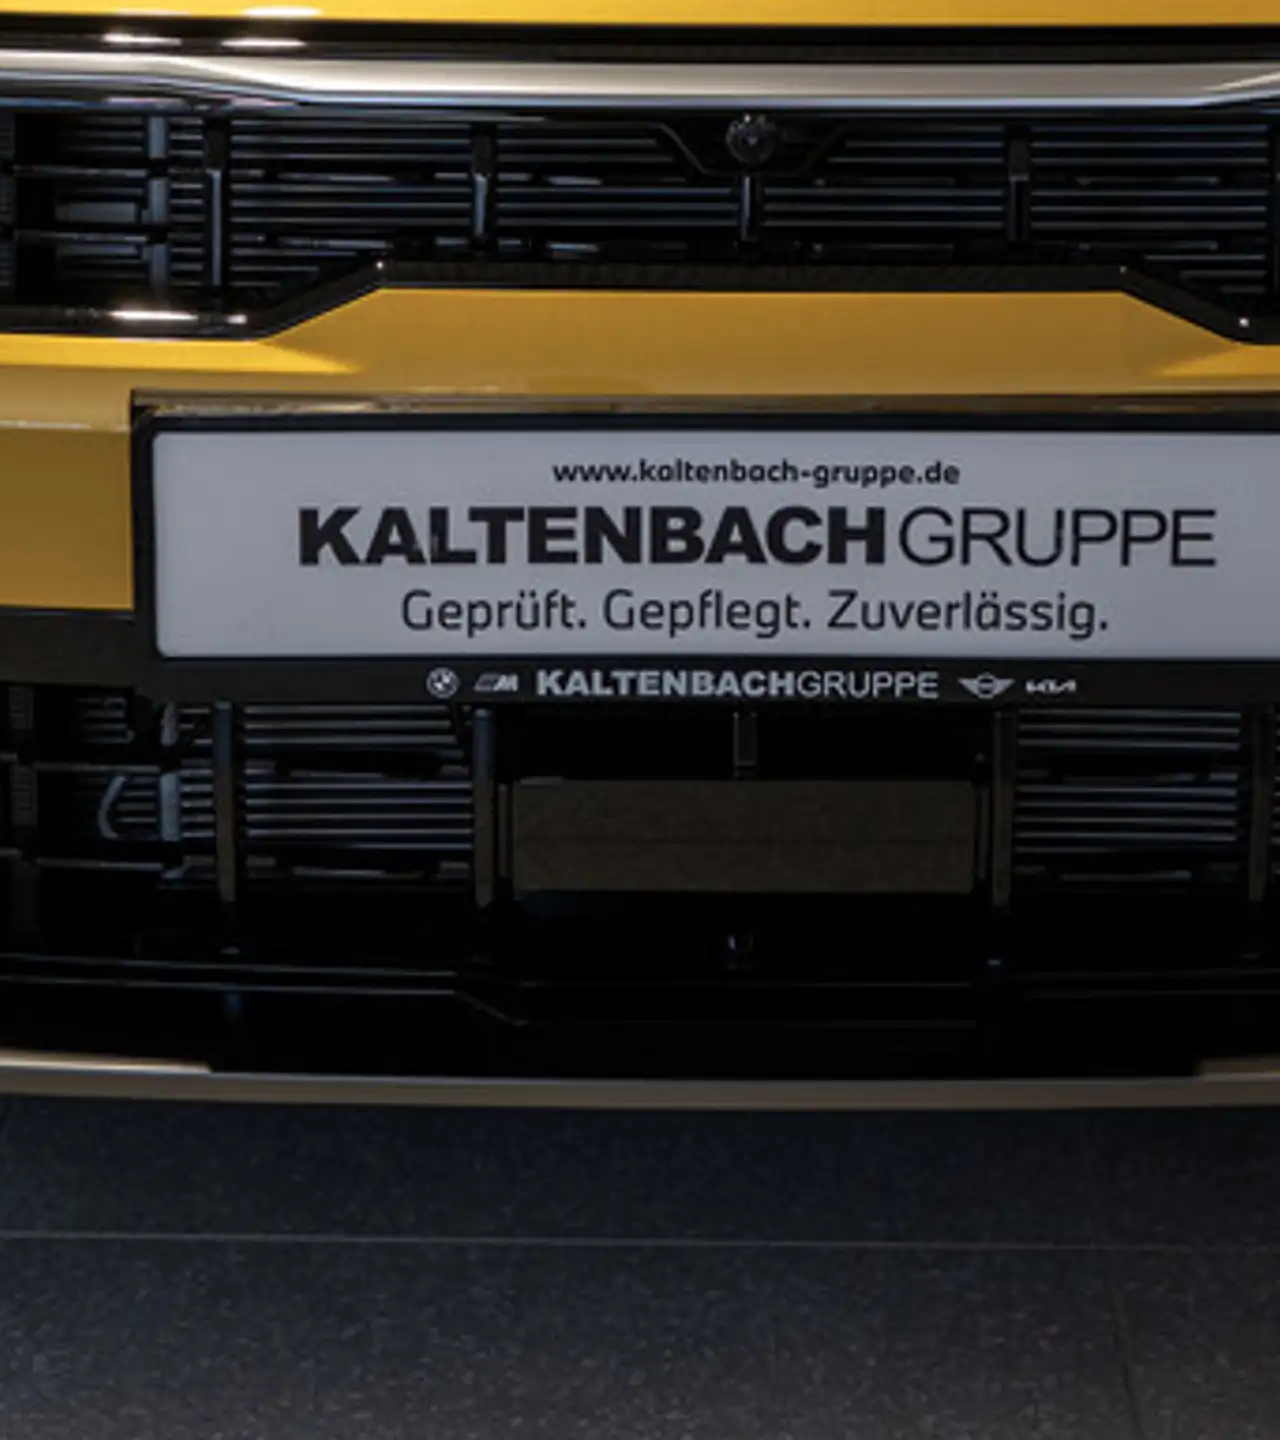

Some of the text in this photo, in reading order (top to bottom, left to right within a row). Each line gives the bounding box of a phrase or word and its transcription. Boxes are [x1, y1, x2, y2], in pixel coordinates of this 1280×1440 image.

[552, 457, 961, 489] www.kaltenbach-gruppe.de
[401, 587, 1109, 641] Geprüft. Gepflegt. Zuverlässig.
